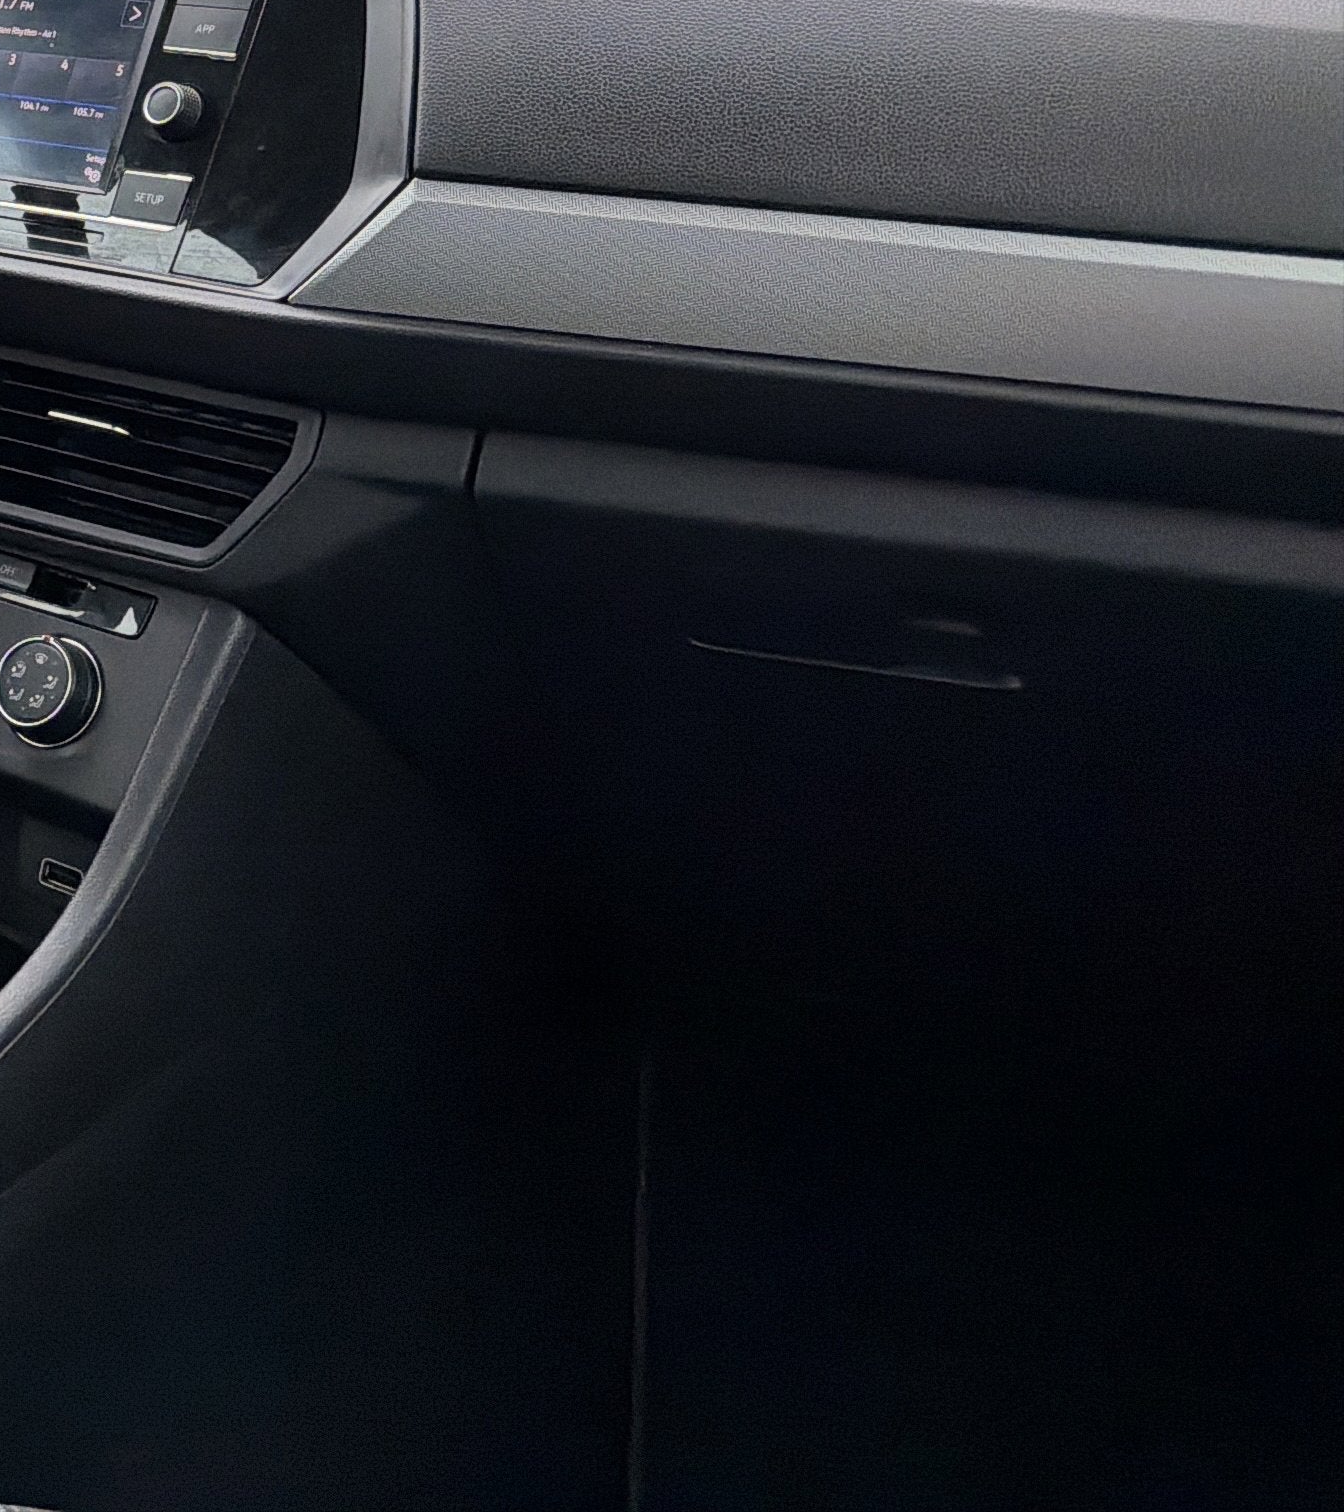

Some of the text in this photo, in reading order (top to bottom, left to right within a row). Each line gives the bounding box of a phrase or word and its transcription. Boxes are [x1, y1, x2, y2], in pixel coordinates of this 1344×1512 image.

[19, 0, 35, 12] FM
[195, 23, 215, 34] APP
[8, 53, 16, 65] 3
[61, 59, 69, 71] 4
[115, 64, 125, 76] 5
[73, 106, 95, 118] 105.7
[134, 191, 164, 205] SETUP
[0, 564, 17, 576] OFF
